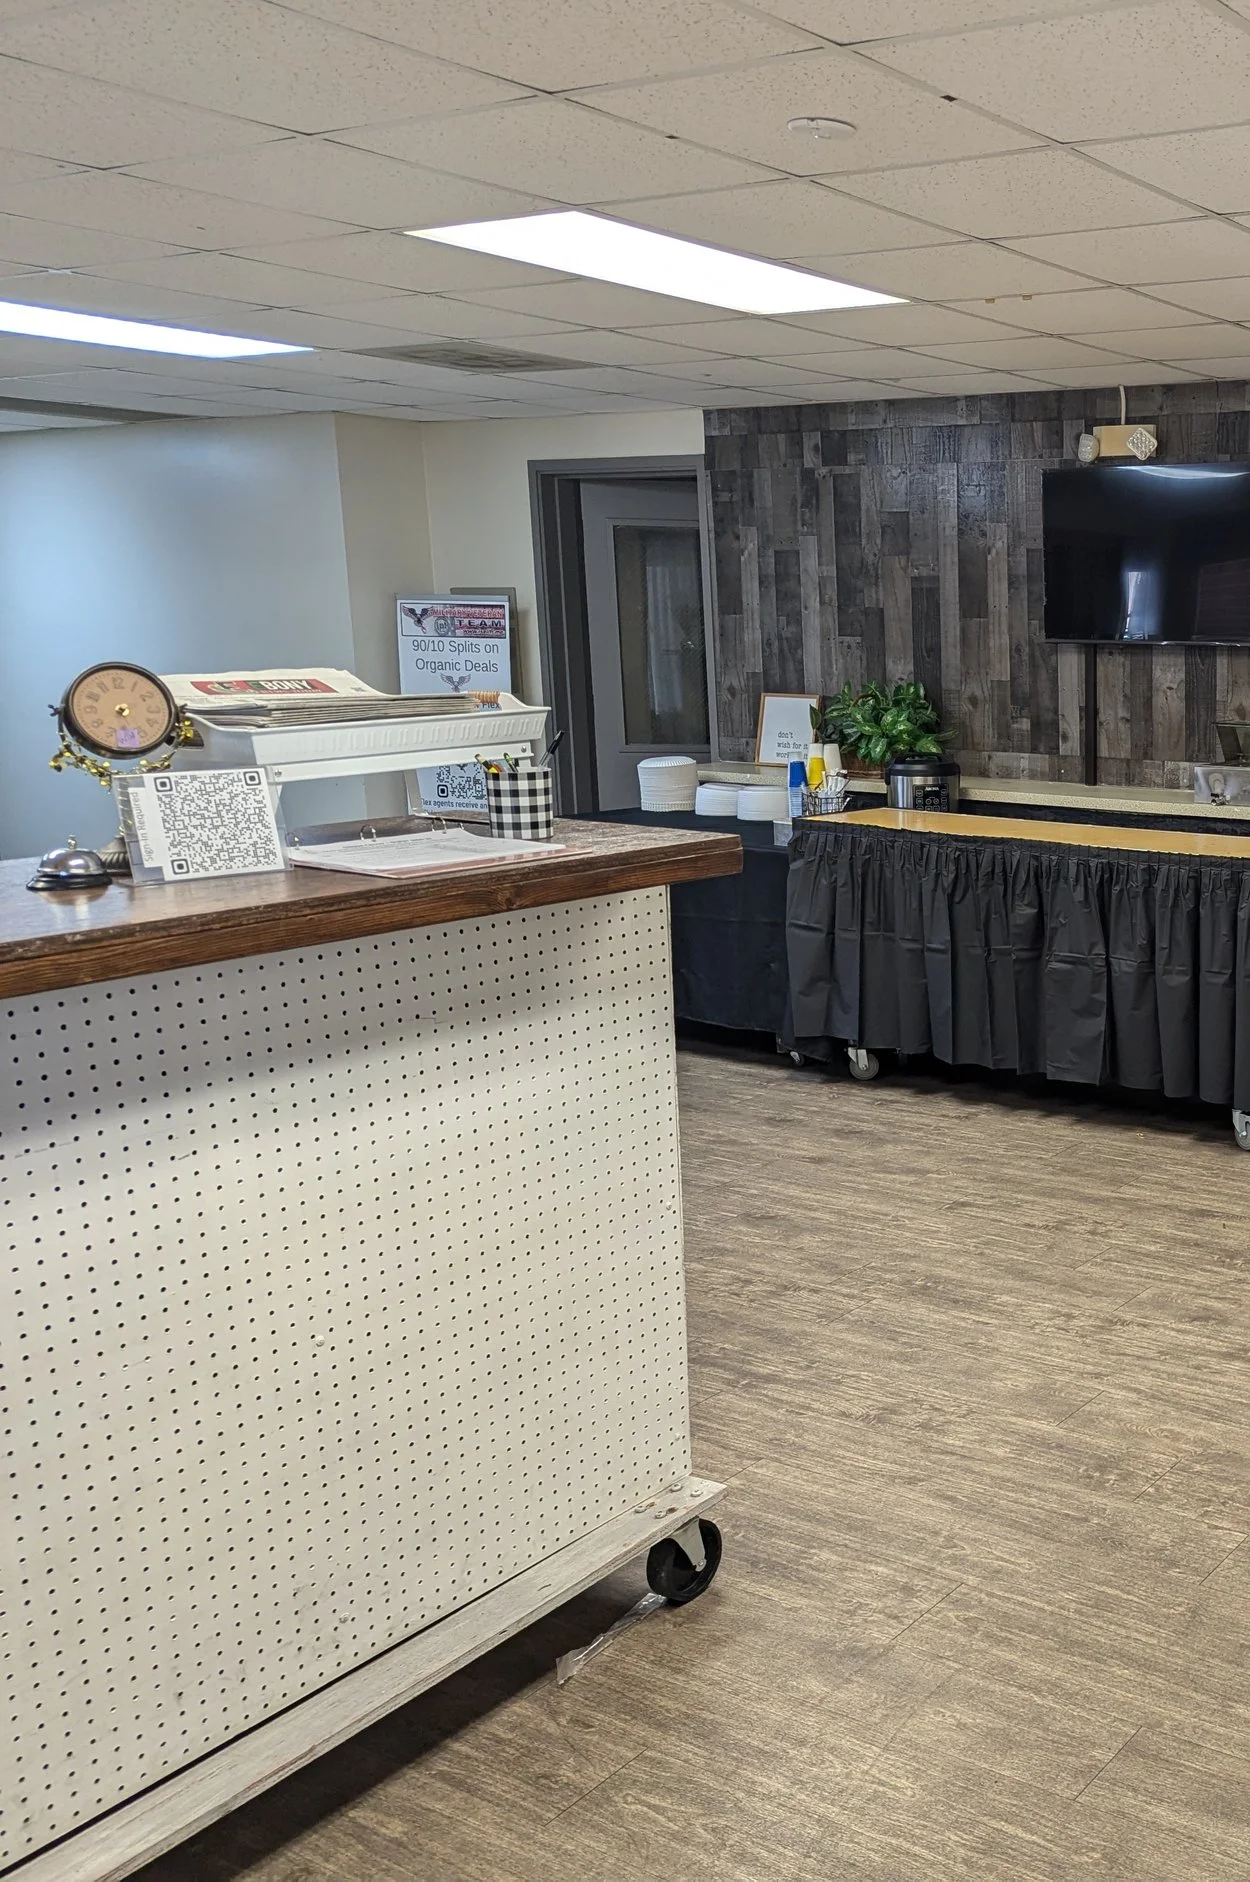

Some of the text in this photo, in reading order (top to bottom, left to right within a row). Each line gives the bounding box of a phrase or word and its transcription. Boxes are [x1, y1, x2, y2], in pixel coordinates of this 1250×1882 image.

[456, 619, 502, 627] TEAM
[412, 639, 499, 656] 90/10 Splits on
[415, 658, 499, 673] Organic Deals
[792, 742, 802, 750] for
[433, 799, 454, 809] agents
[455, 800, 478, 809] receive
[131, 791, 147, 831] Required
